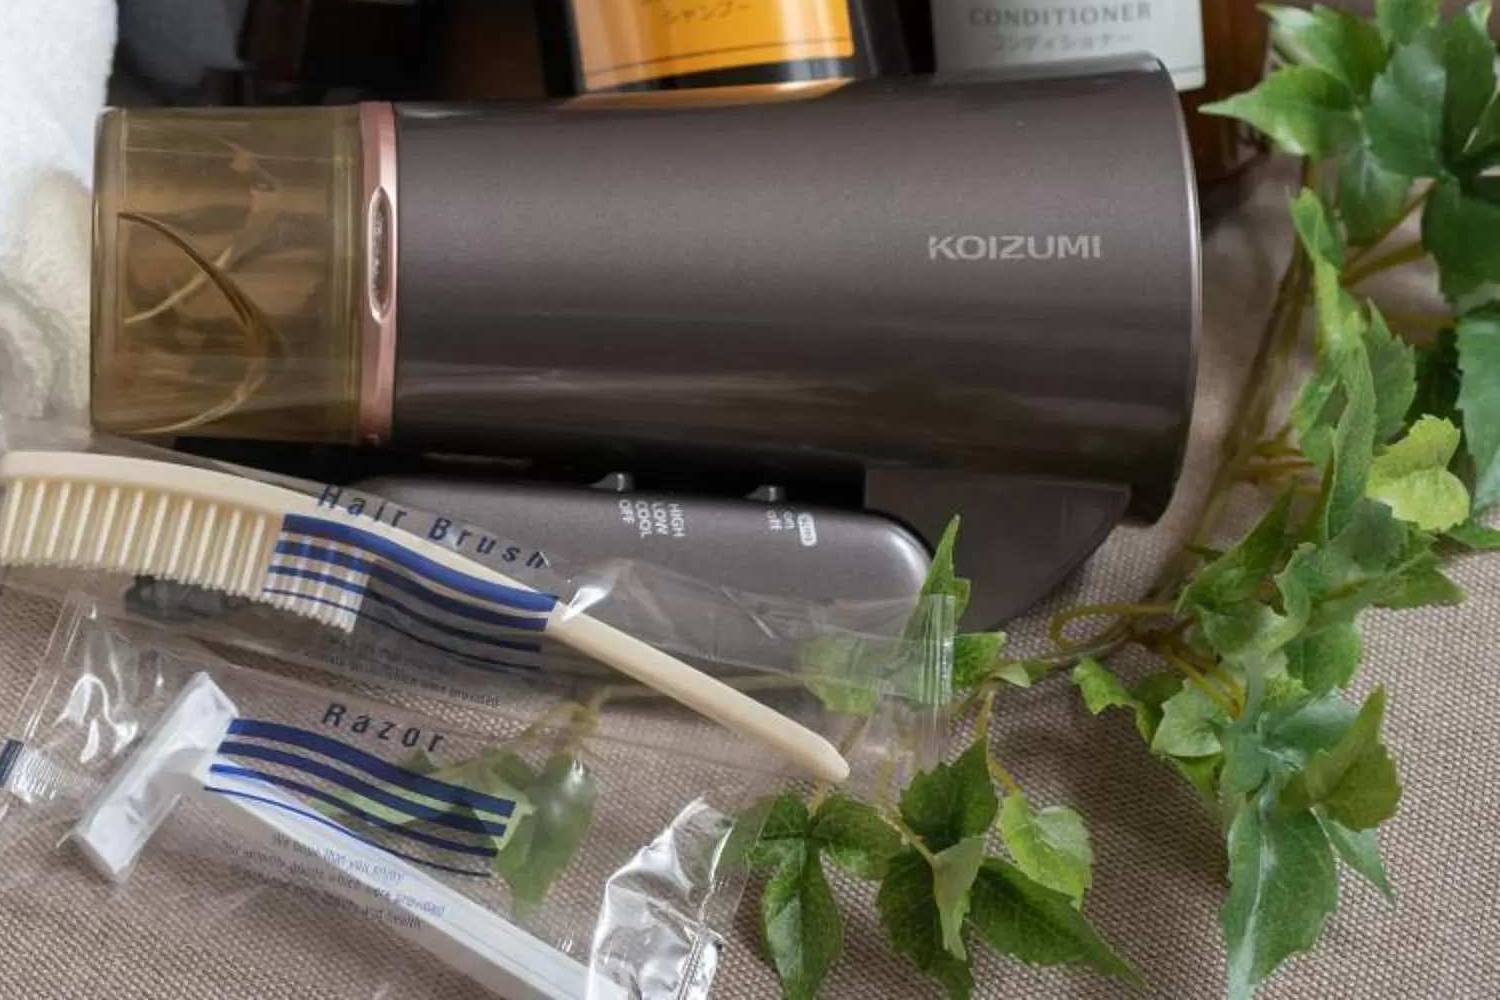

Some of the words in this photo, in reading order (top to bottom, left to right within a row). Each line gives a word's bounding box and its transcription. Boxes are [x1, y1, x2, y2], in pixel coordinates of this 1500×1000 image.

[661, 1, 752, 25] シャンプー
[967, 2, 1152, 27] CONDITIONER
[928, 234, 1101, 261] KOIZUMI
[619, 499, 634, 524] OFF
[635, 500, 652, 538] COOL
[668, 503, 686, 537] HIGH
[317, 484, 408, 529] Hair
[428, 516, 549, 570] Brush
[322, 703, 446, 753] Razor
